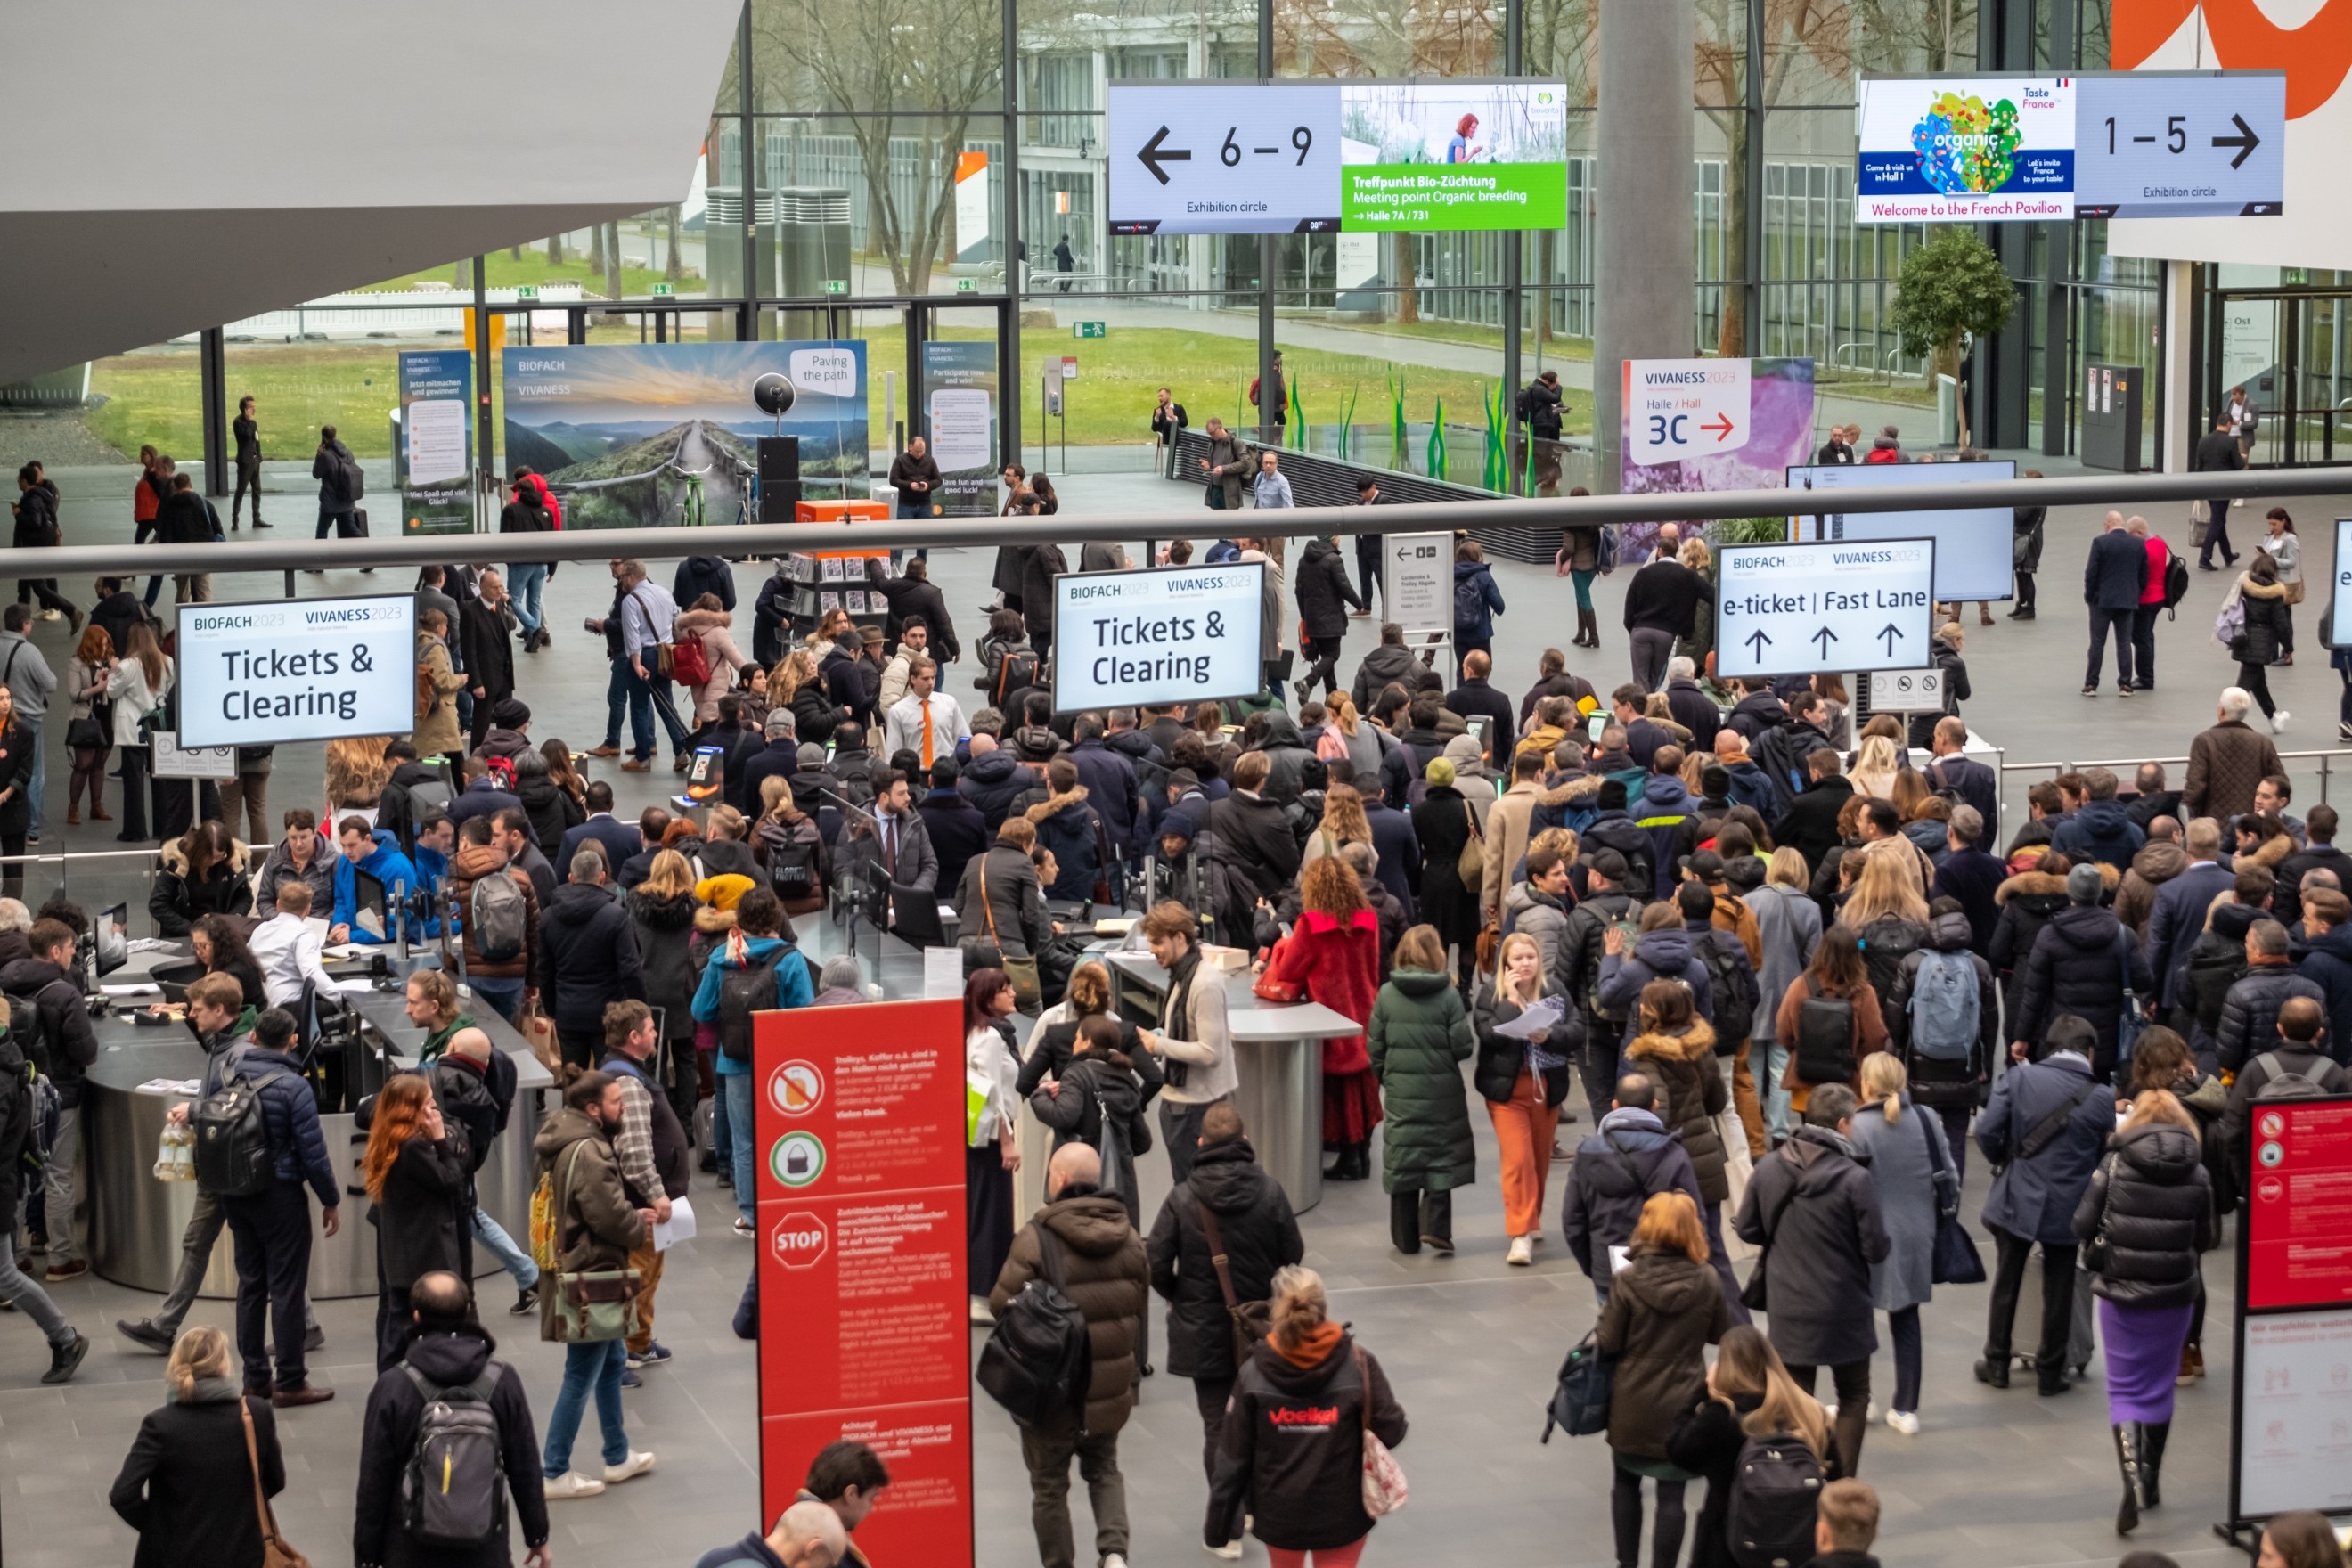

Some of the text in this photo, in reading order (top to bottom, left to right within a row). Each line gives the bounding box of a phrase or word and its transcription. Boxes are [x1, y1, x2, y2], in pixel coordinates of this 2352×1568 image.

[2023, 87, 2049, 97] Taste
[2022, 98, 2054, 108] France
[1934, 131, 1998, 151] organic
[2105, 117, 2115, 154] 1
[2168, 116, 2185, 153] 5
[1221, 127, 1241, 167] 6
[1292, 126, 1312, 166] 9
[1891, 163, 1905, 171] visit
[1353, 175, 1496, 190] Treffpunkt Bio-Züchtung
[1882, 172, 1899, 181] Hall
[2046, 175, 2064, 183] table!
[1353, 189, 1527, 206] Meeting point Organic breeding
[2144, 186, 2217, 197] Exhibition circle
[1187, 201, 1267, 213] Exhibition circle
[1872, 201, 2062, 216] Welcome to the French Pavilion
[1366, 210, 1428, 221] Halle 7A / 731
[2234, 317, 2250, 325] Ost
[519, 360, 565, 372] BIOFACH
[812, 355, 847, 368] Paving
[804, 370, 847, 382] the path
[933, 369, 968, 378] Participate
[1646, 371, 1735, 384] VIVANESS2023
[409, 379, 461, 388] Jetzt mitmachen
[519, 384, 570, 396] VIVANESS
[426, 387, 459, 396] gewinnen!
[1647, 398, 1701, 410] Halle / Hall
[1649, 414, 1687, 445] 3C
[970, 478, 983, 486] and
[410, 490, 422, 498] Viel
[423, 490, 439, 498] Spaß
[944, 486, 978, 494] good luck!
[429, 497, 448, 505] Glück!
[1733, 555, 1815, 569] BIOFACH2023
[1833, 549, 1921, 565] VIVANESS2023
[1167, 574, 1251, 592] VIVANESS2023
[1070, 582, 1149, 599] BIOFACH2023
[1724, 593, 1805, 616] e-ticket
[1825, 591, 1869, 610] Fast
[1877, 589, 1926, 608] Lane
[306, 606, 402, 624] VIVANESS2023
[194, 613, 285, 631] BIOFACH2023
[1093, 610, 1225, 647] Tickets &
[221, 643, 373, 680] Tickets &
[1093, 651, 1210, 685] Clearing
[222, 685, 357, 721] Clearing
[836, 1107, 888, 1119] Vielen Dank.
[777, 1230, 822, 1250] STOP
[1269, 1405, 1339, 1425] Voelkel
